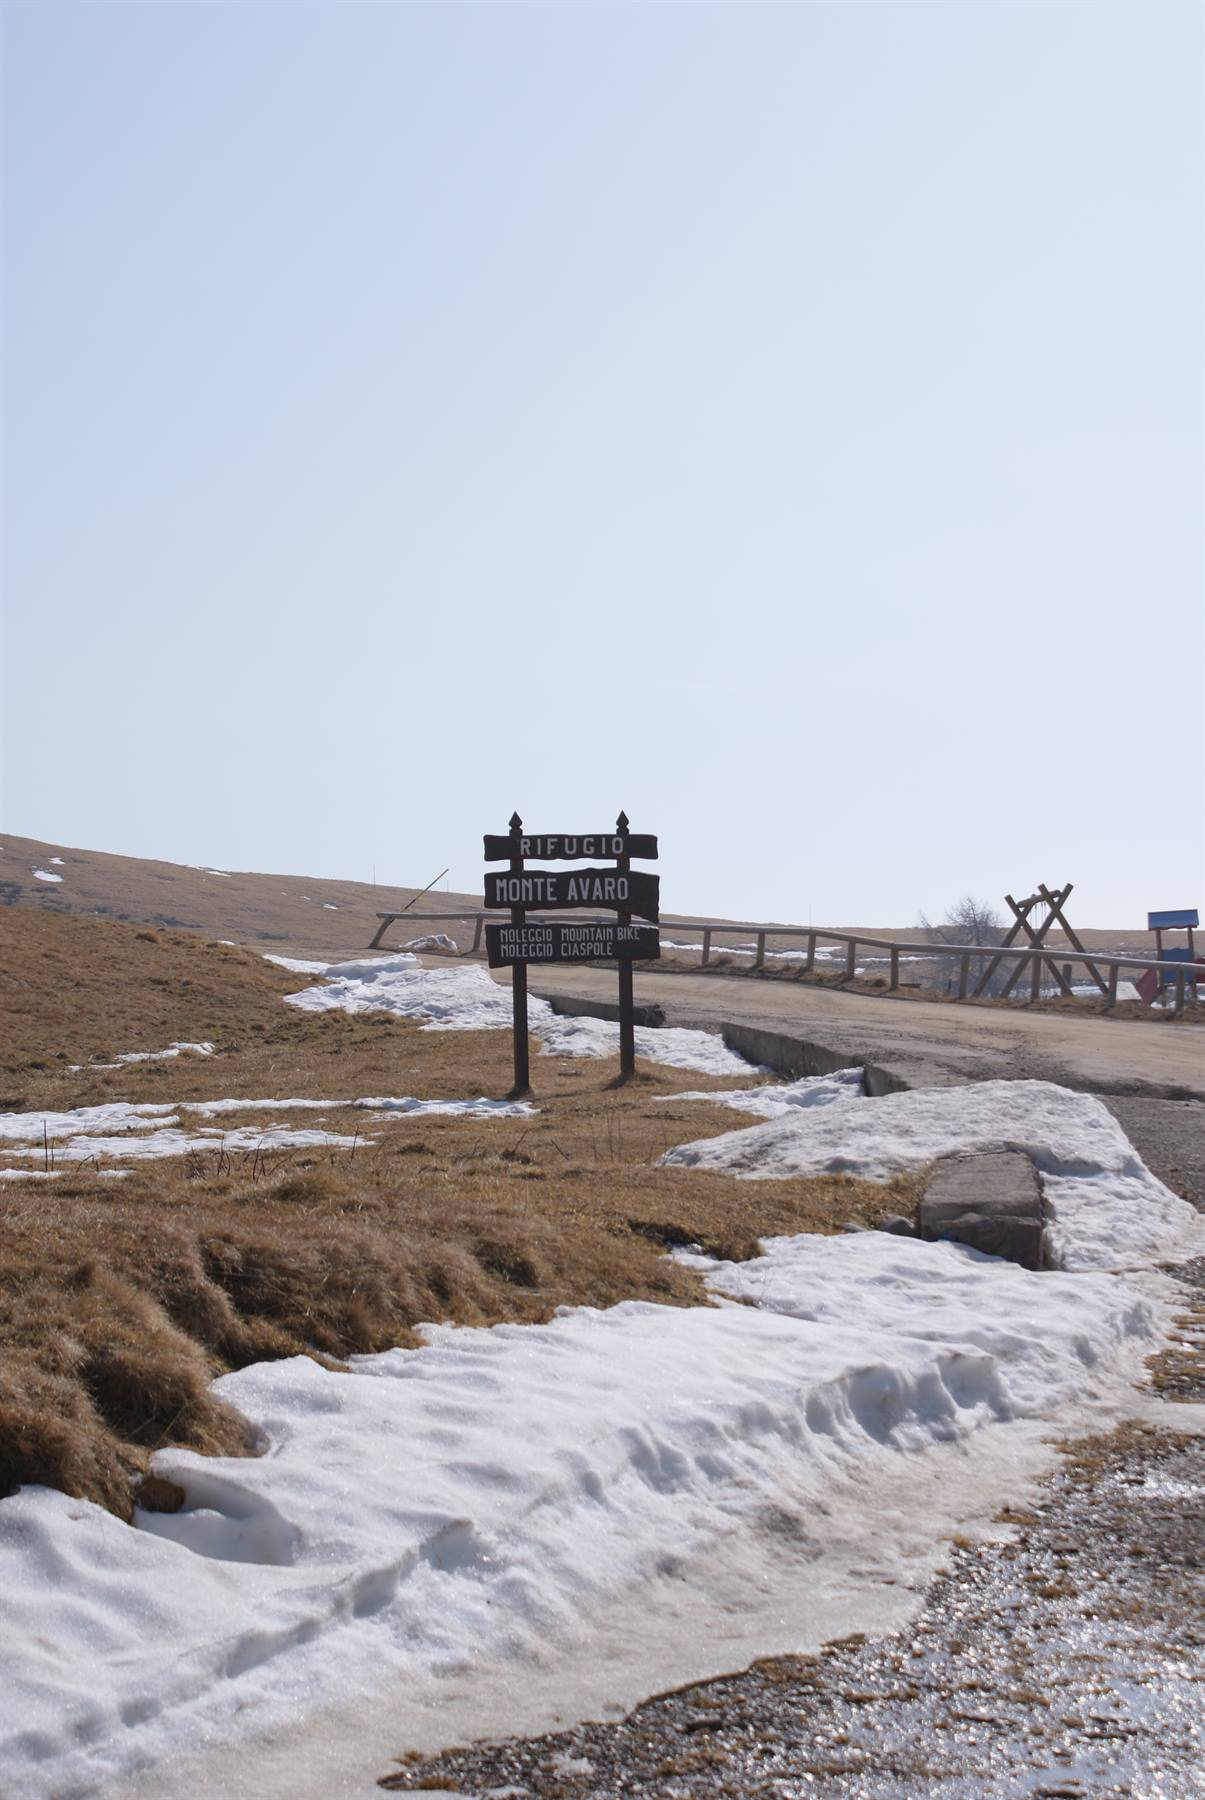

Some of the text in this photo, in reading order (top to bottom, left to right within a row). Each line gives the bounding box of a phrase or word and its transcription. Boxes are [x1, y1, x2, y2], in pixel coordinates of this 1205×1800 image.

[520, 837, 624, 855] RIFUGIO
[495, 878, 628, 902] MONTE AVARO
[500, 927, 640, 943] NOLEGGIO MOUNTAIN BIKE
[501, 942, 613, 958] NOLEGGIO CIASPOLE
